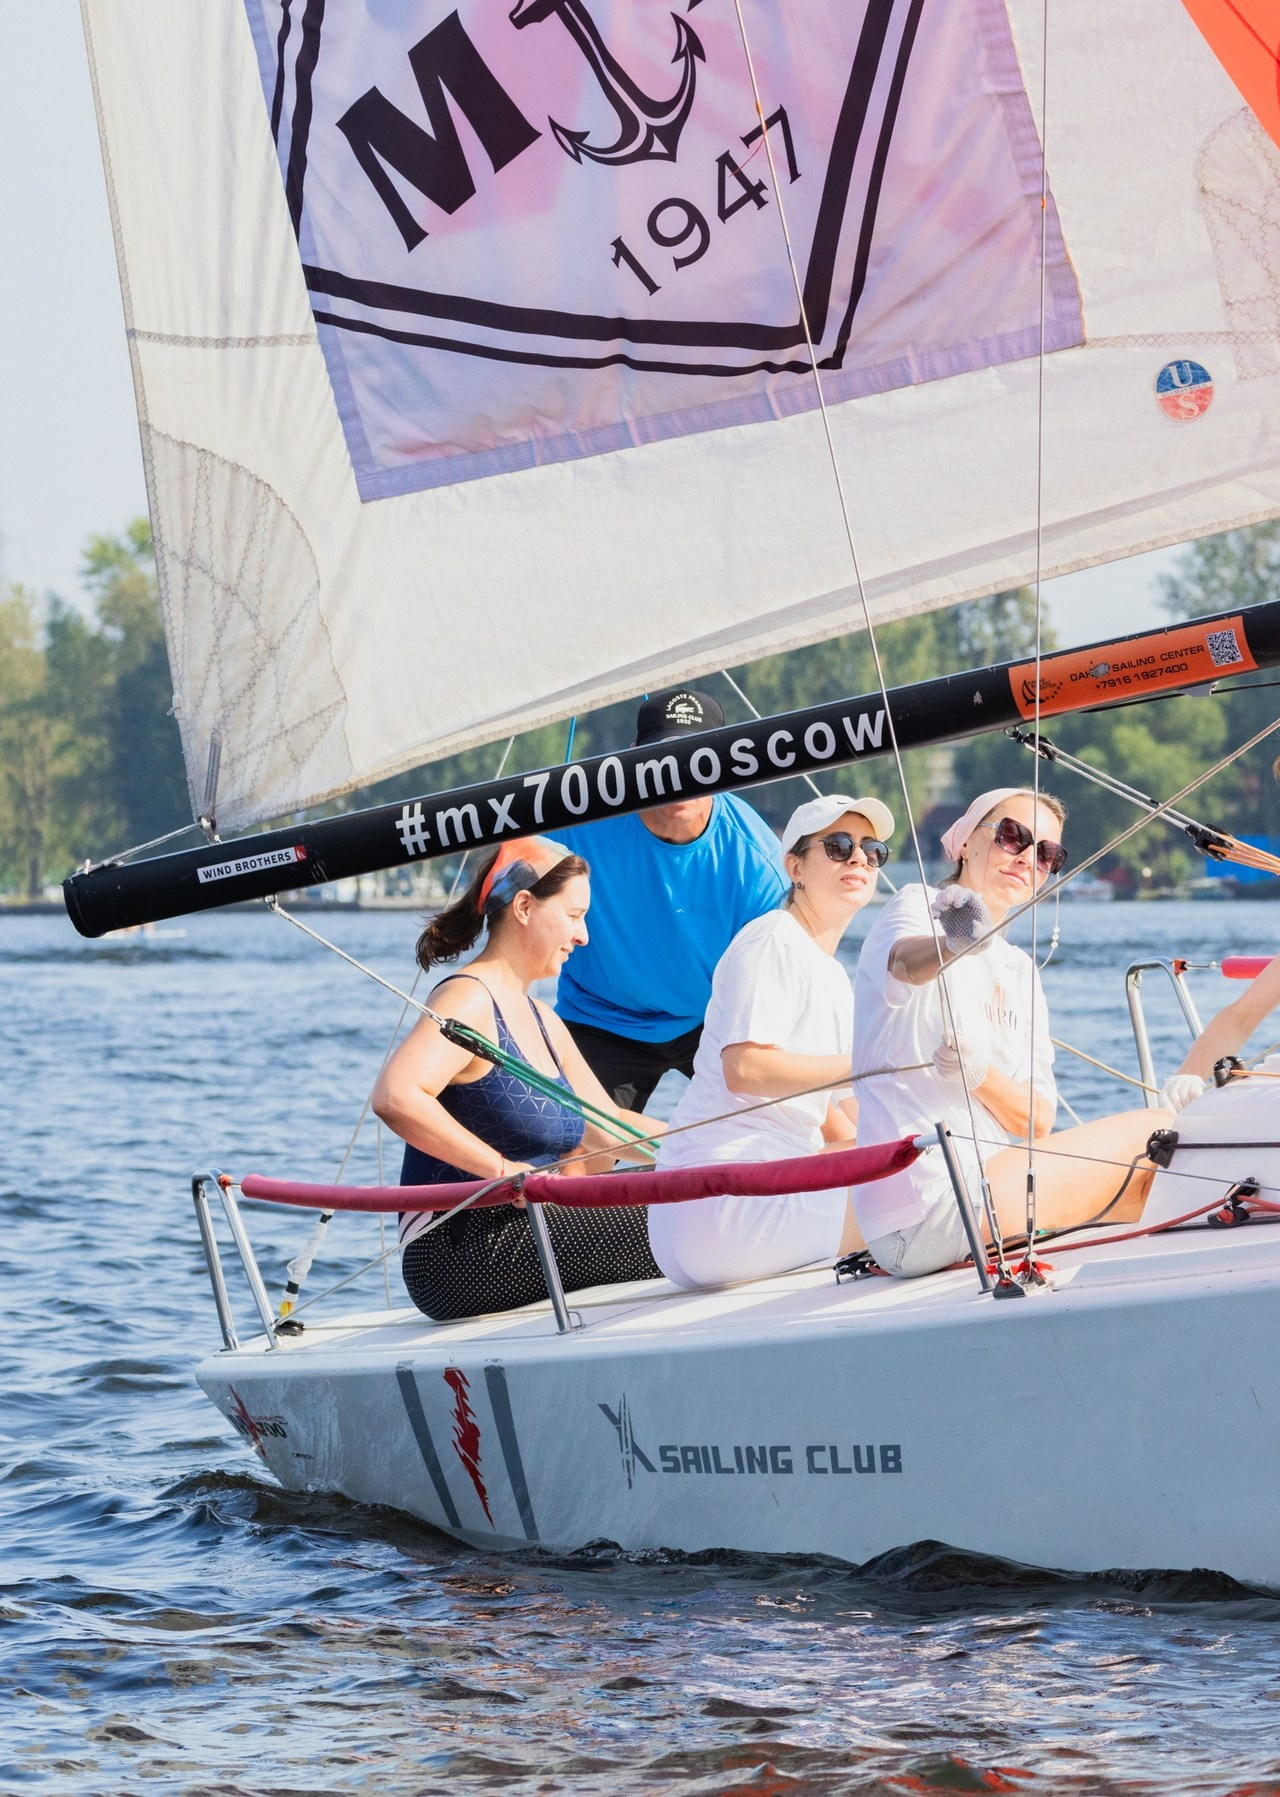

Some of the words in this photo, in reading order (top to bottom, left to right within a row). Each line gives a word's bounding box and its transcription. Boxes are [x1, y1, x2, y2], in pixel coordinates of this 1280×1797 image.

[610, 105, 802, 296] 1947
[1111, 655, 1156, 672] SAILING
[1160, 644, 1205, 662] CENTER
[1096, 676, 1132, 690] +7916
[1134, 662, 1189, 681] 1927400
[666, 693, 687, 711] LACOSTE
[688, 694, 704, 714] FRANCE
[688, 714, 703, 723] CLUB
[395, 709, 886, 856] #mx700moscow
[202, 865, 232, 880] WIND
[234, 851, 292, 872] BROTHERS
[658, 1445, 794, 1475] SAILING
[806, 1444, 903, 1475] CLUB
